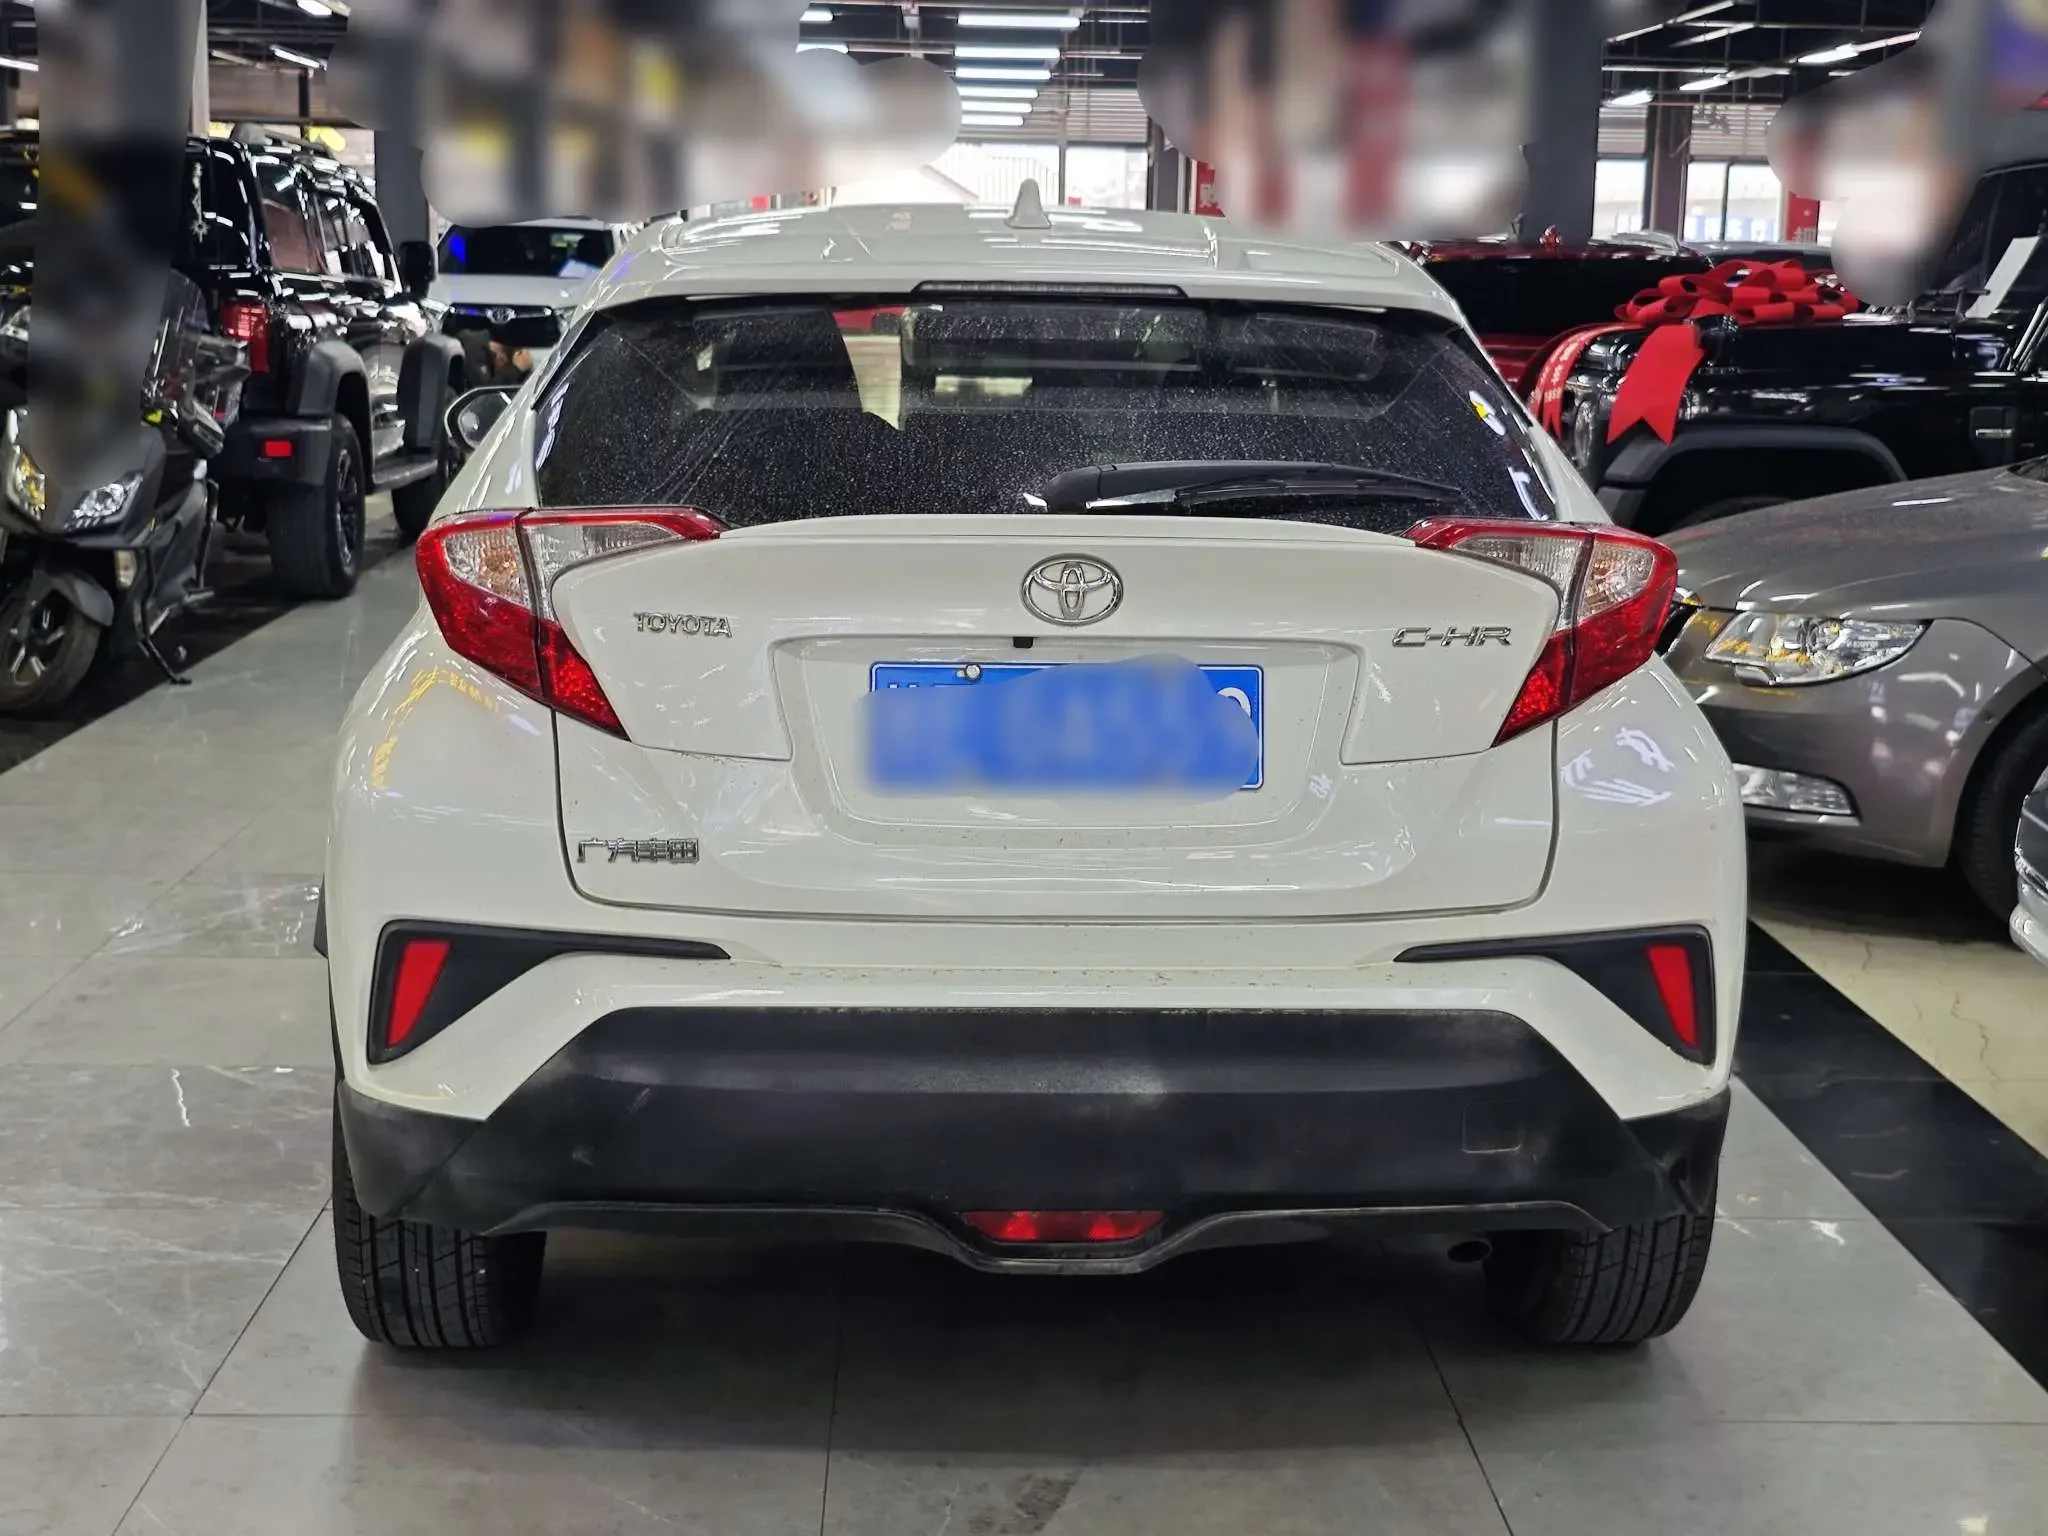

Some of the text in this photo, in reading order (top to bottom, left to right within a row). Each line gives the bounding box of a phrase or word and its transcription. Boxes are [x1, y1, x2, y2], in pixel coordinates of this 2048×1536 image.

[633, 612, 732, 638] TOYOTA
[1392, 626, 1511, 647] C-HR
[577, 837, 699, 864] 广汽丰田
